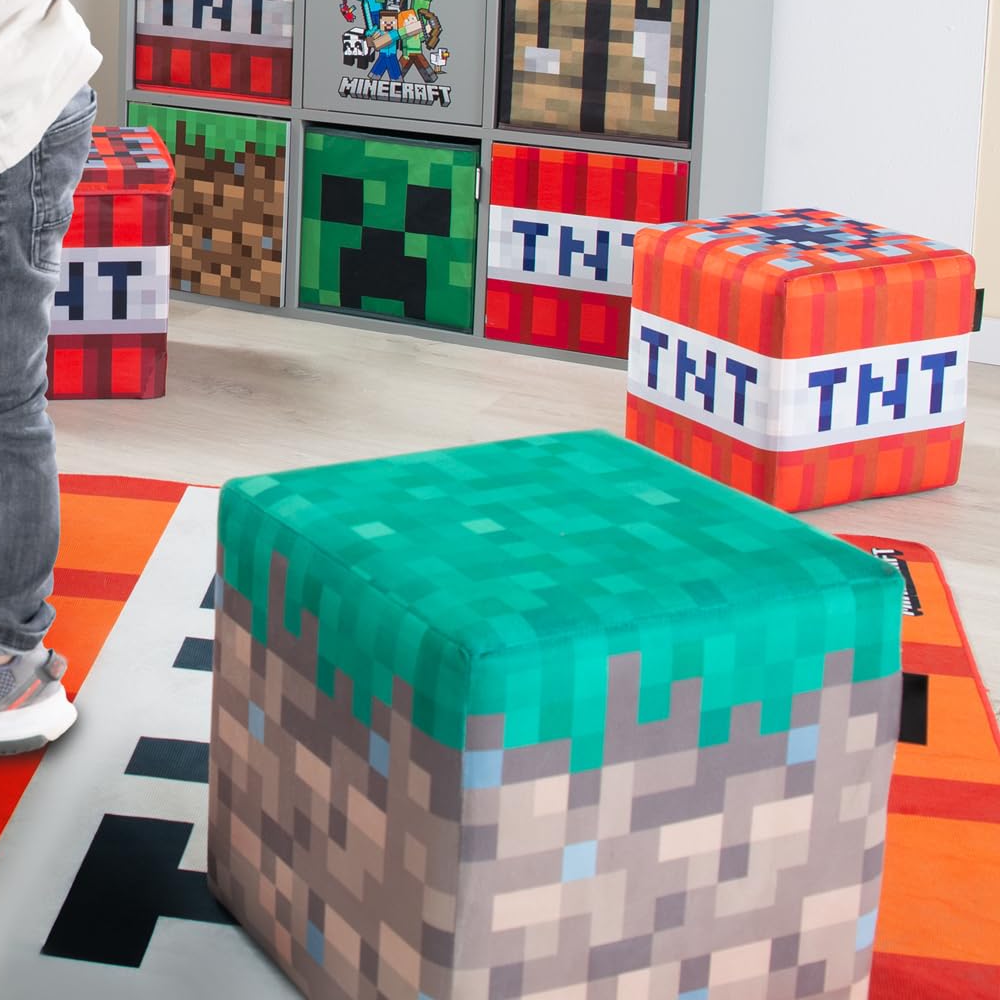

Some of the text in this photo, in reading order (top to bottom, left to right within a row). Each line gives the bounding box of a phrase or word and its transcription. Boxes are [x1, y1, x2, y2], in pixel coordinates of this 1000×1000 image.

[338, 76, 451, 107] MINECRAFT
[640, 325, 757, 427] TNT
[808, 350, 957, 432] TNT
